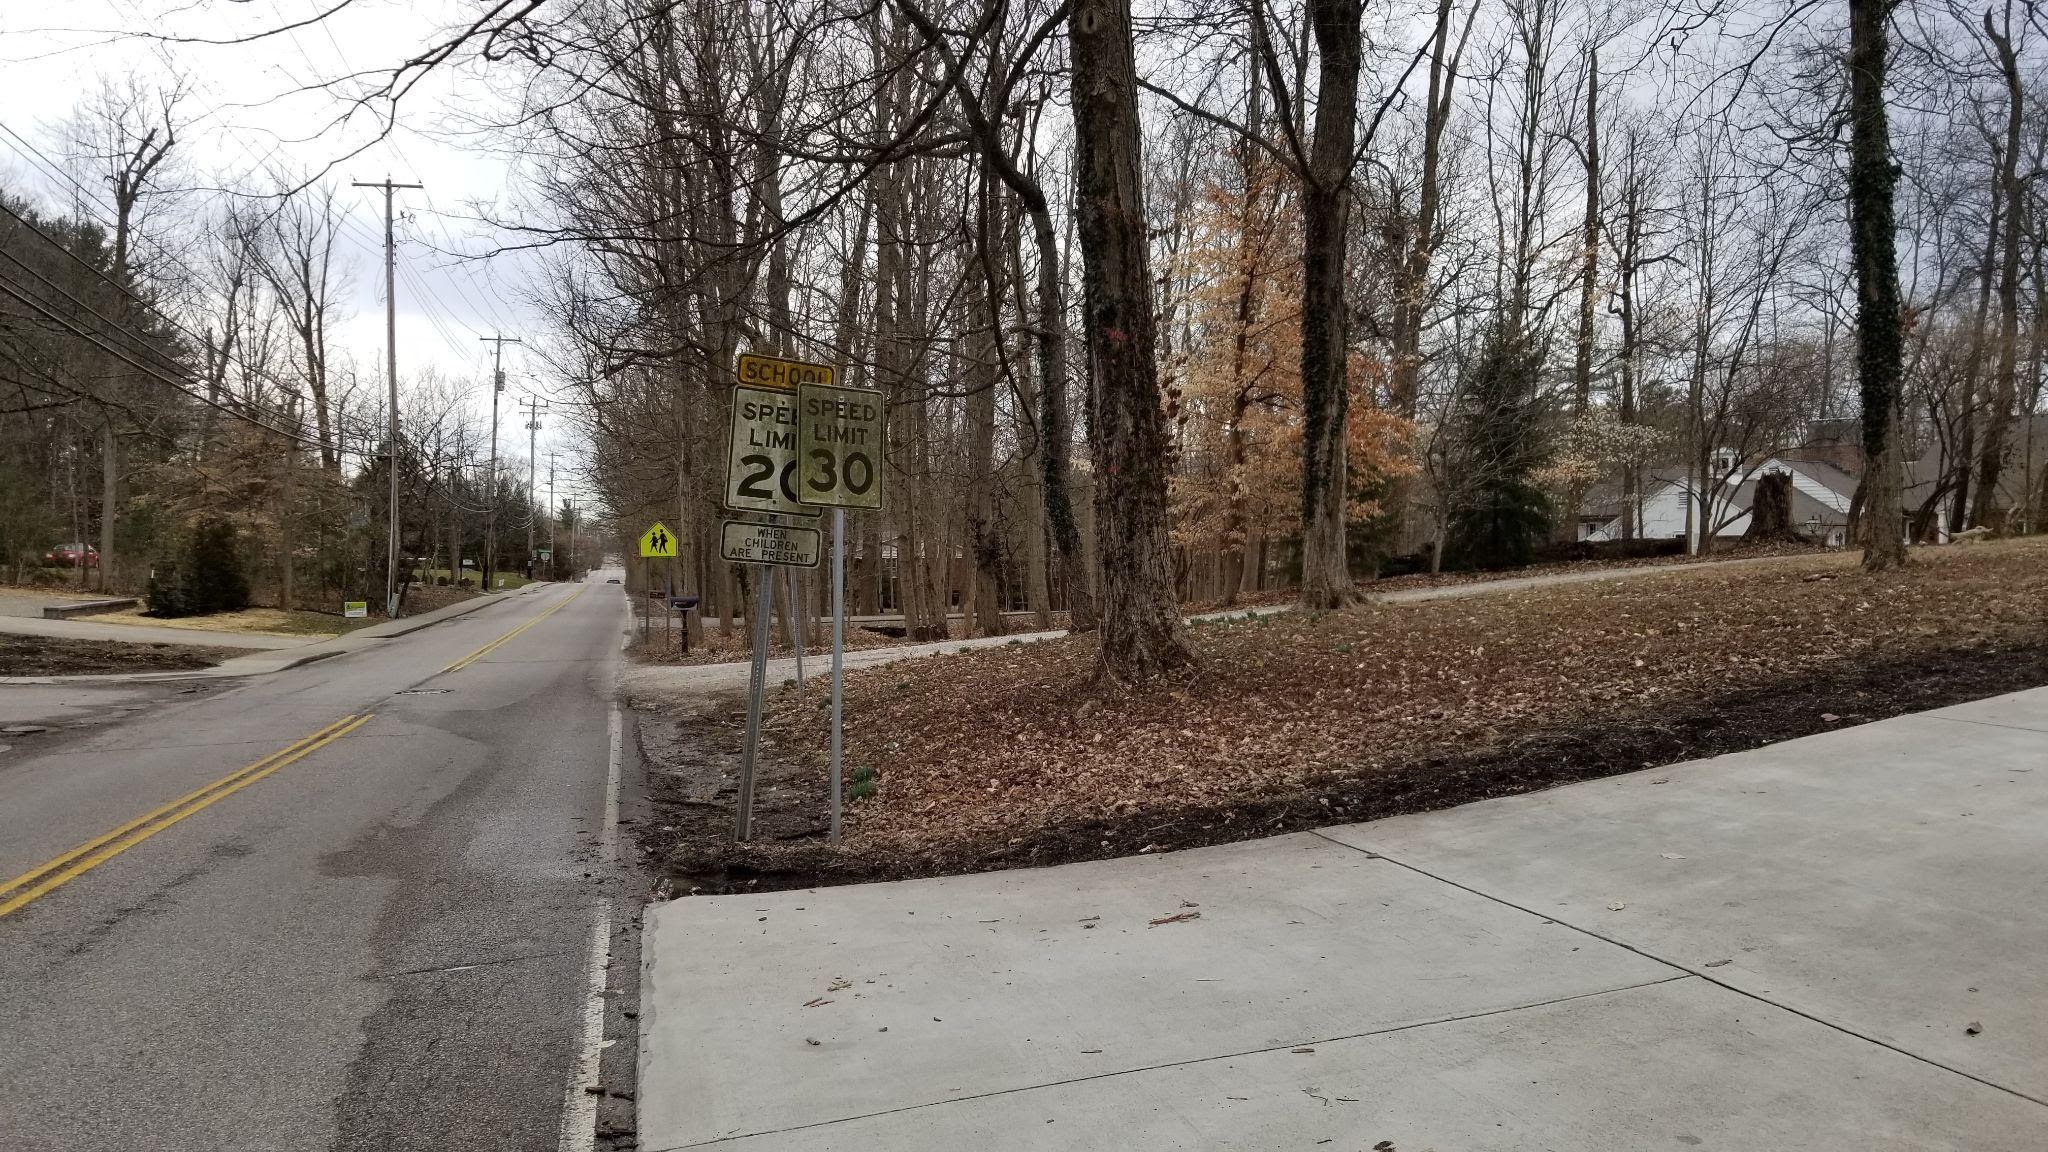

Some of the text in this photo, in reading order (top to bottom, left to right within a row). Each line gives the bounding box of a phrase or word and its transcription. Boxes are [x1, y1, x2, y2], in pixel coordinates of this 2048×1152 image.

[742, 402, 797, 425] SPE
[807, 398, 877, 422] SPEED
[750, 428, 797, 451] LIMI
[814, 423, 868, 446] LIMIT
[807, 448, 874, 496] 30
[745, 538, 798, 551] CHILDREN
[757, 528, 787, 540] WHEN
[730, 548, 810, 563] ARE PRESENT
